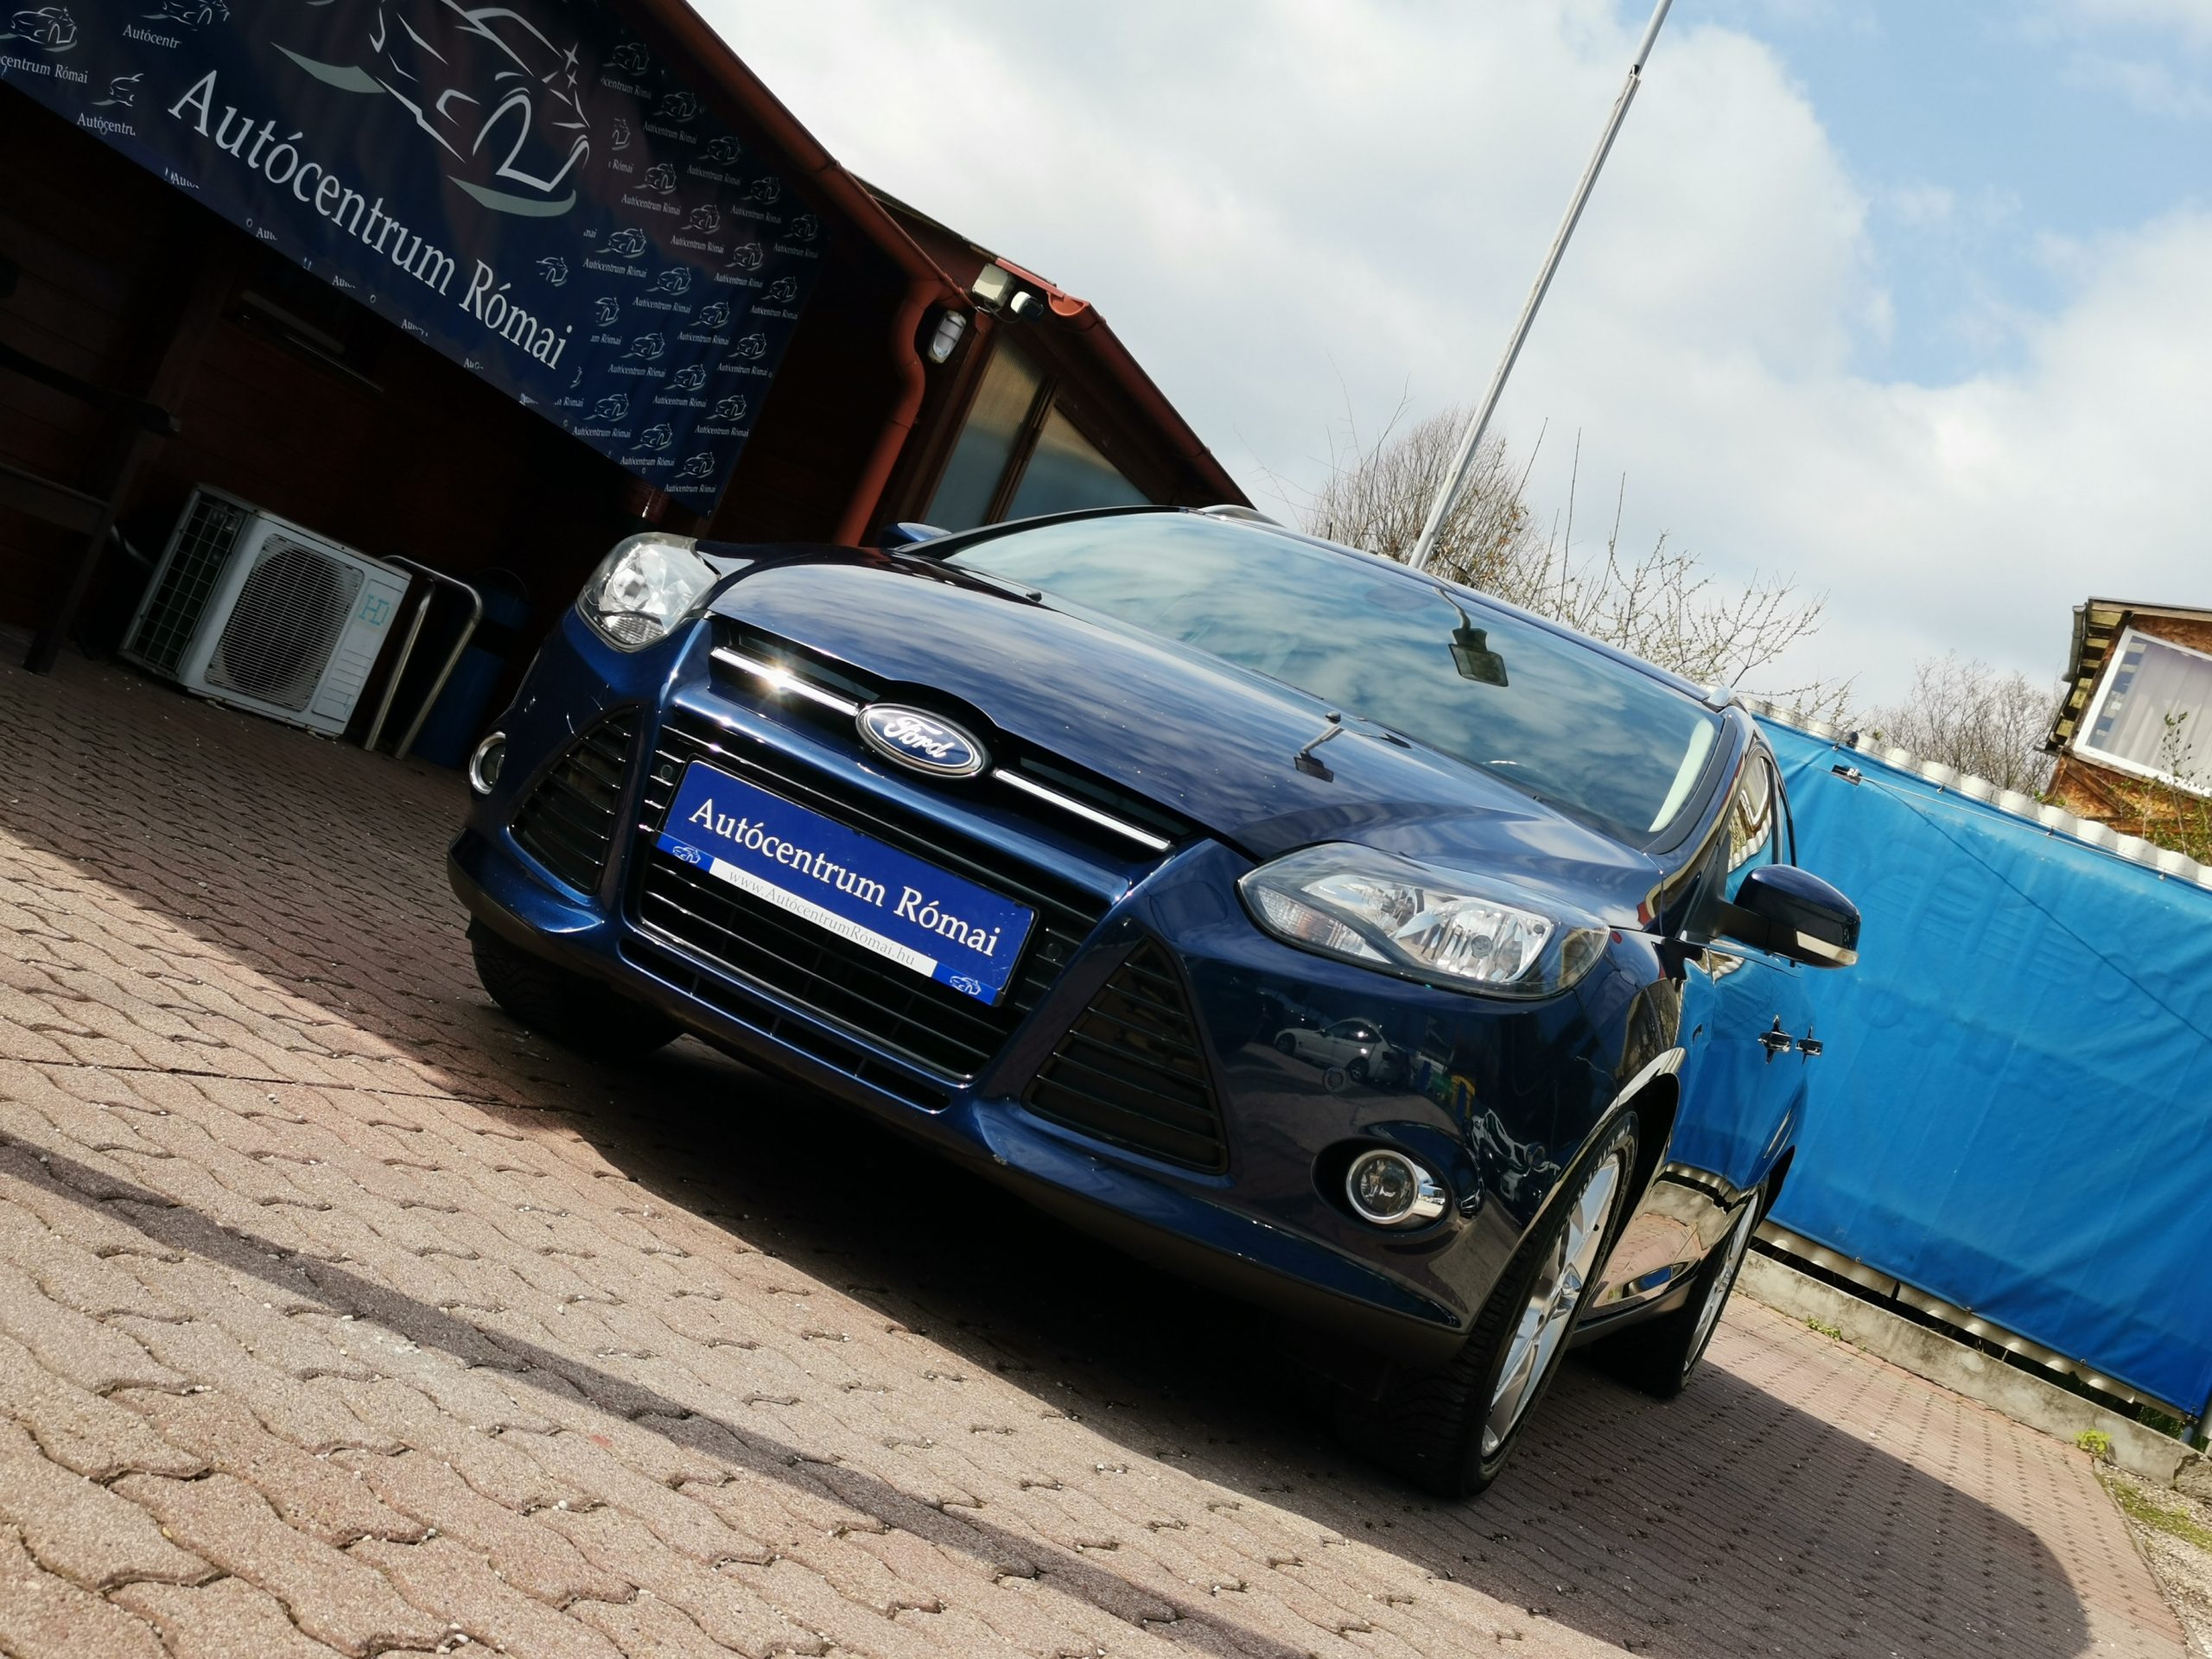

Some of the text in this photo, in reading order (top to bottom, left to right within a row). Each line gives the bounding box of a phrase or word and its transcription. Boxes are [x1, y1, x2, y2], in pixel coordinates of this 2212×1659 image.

[54, 64, 89, 84] Római
[168, 69, 574, 371] Autócentrum Római
[582, 257, 649, 278] Autócentrum Római
[883, 716, 956, 759] Ford
[689, 798, 1001, 957] Autócentrum Római
[728, 871, 916, 967] www.AutócentrumRómai.hu
